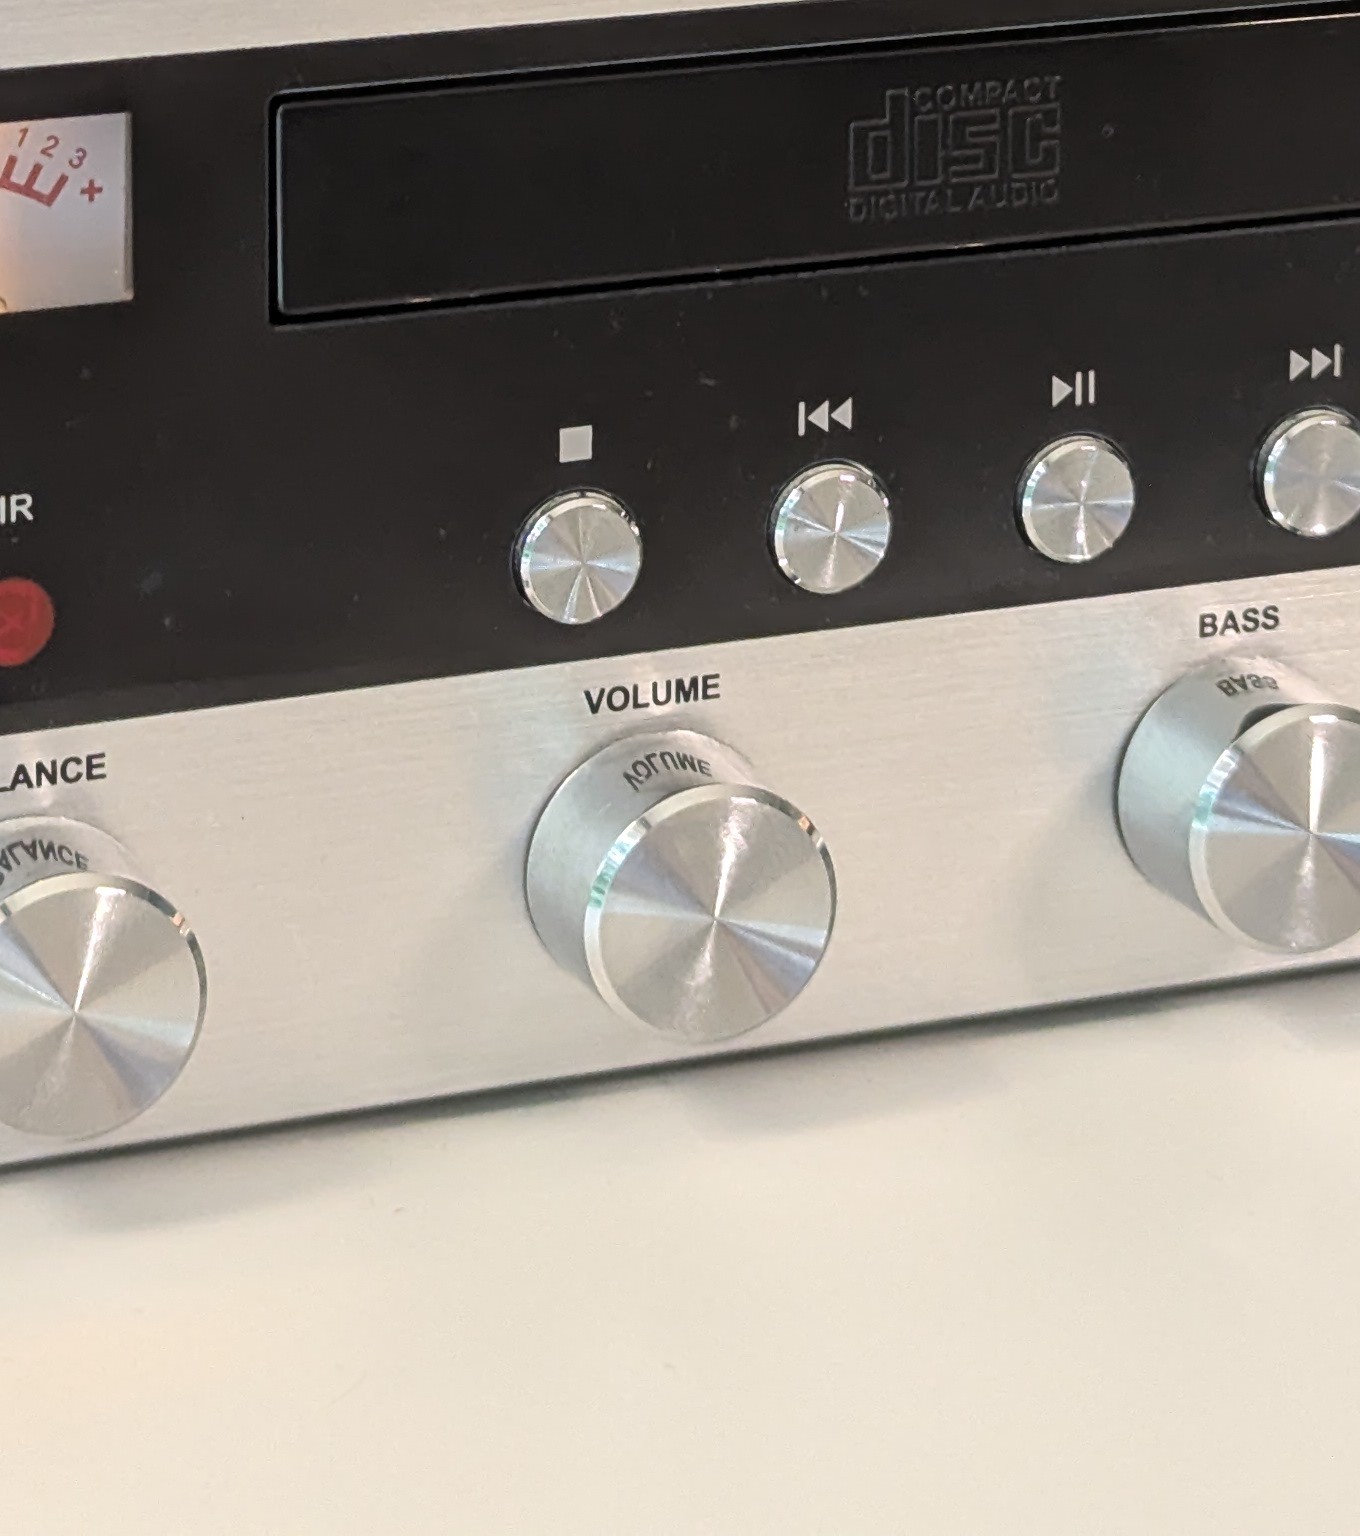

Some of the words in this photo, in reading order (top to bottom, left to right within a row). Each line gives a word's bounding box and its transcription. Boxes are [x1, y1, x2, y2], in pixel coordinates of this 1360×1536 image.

[913, 75, 1061, 111] COMPACT
[40, 135, 60, 158] 2
[69, 147, 87, 169] 3
[848, 190, 961, 222] DIGITAL
[968, 178, 1058, 212] AUDIO
[0, 494, 33, 525] IR
[1198, 604, 1280, 638] BASS
[584, 673, 721, 715] VOLUME
